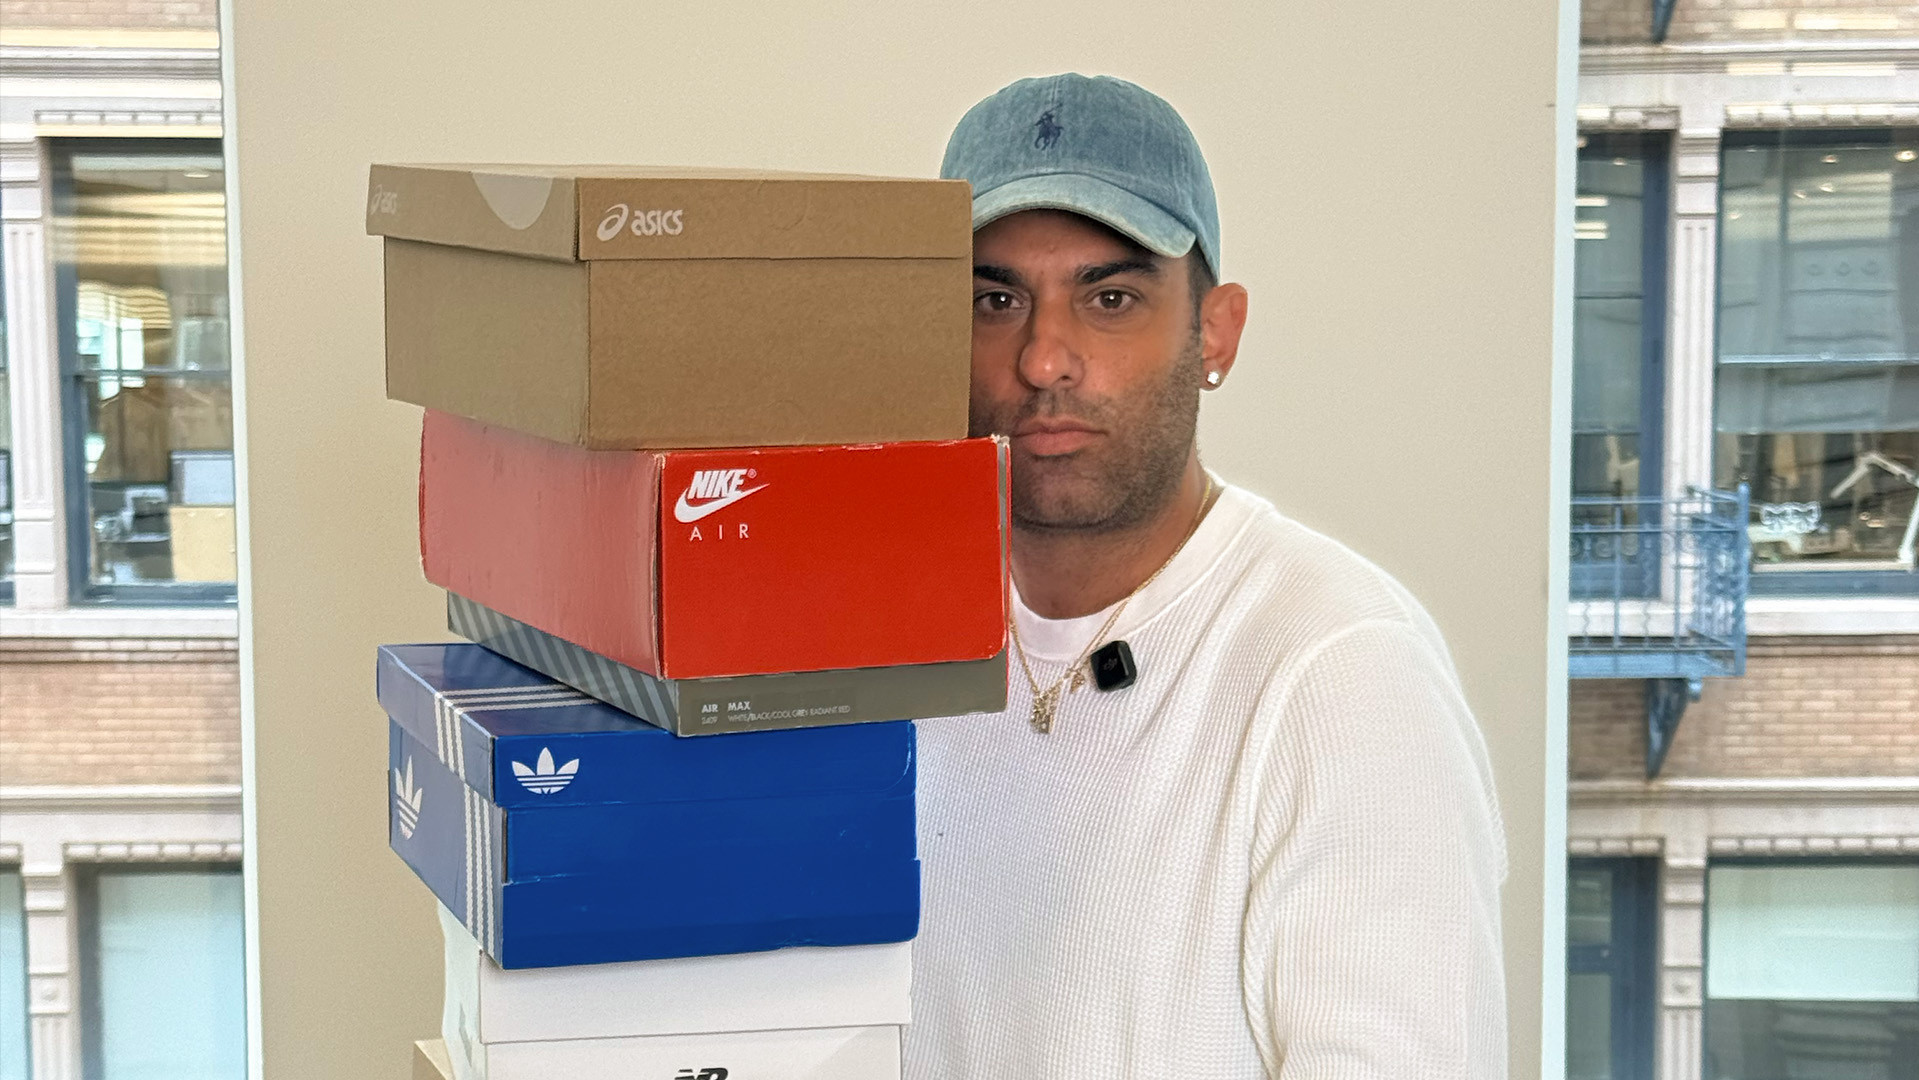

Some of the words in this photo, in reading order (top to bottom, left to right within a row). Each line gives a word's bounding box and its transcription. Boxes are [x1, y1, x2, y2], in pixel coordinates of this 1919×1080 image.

[631, 210, 683, 235] asics
[687, 469, 747, 499] NIKE
[689, 523, 749, 542] AIR
[701, 704, 719, 714] AIR
[727, 701, 752, 712] MAX
